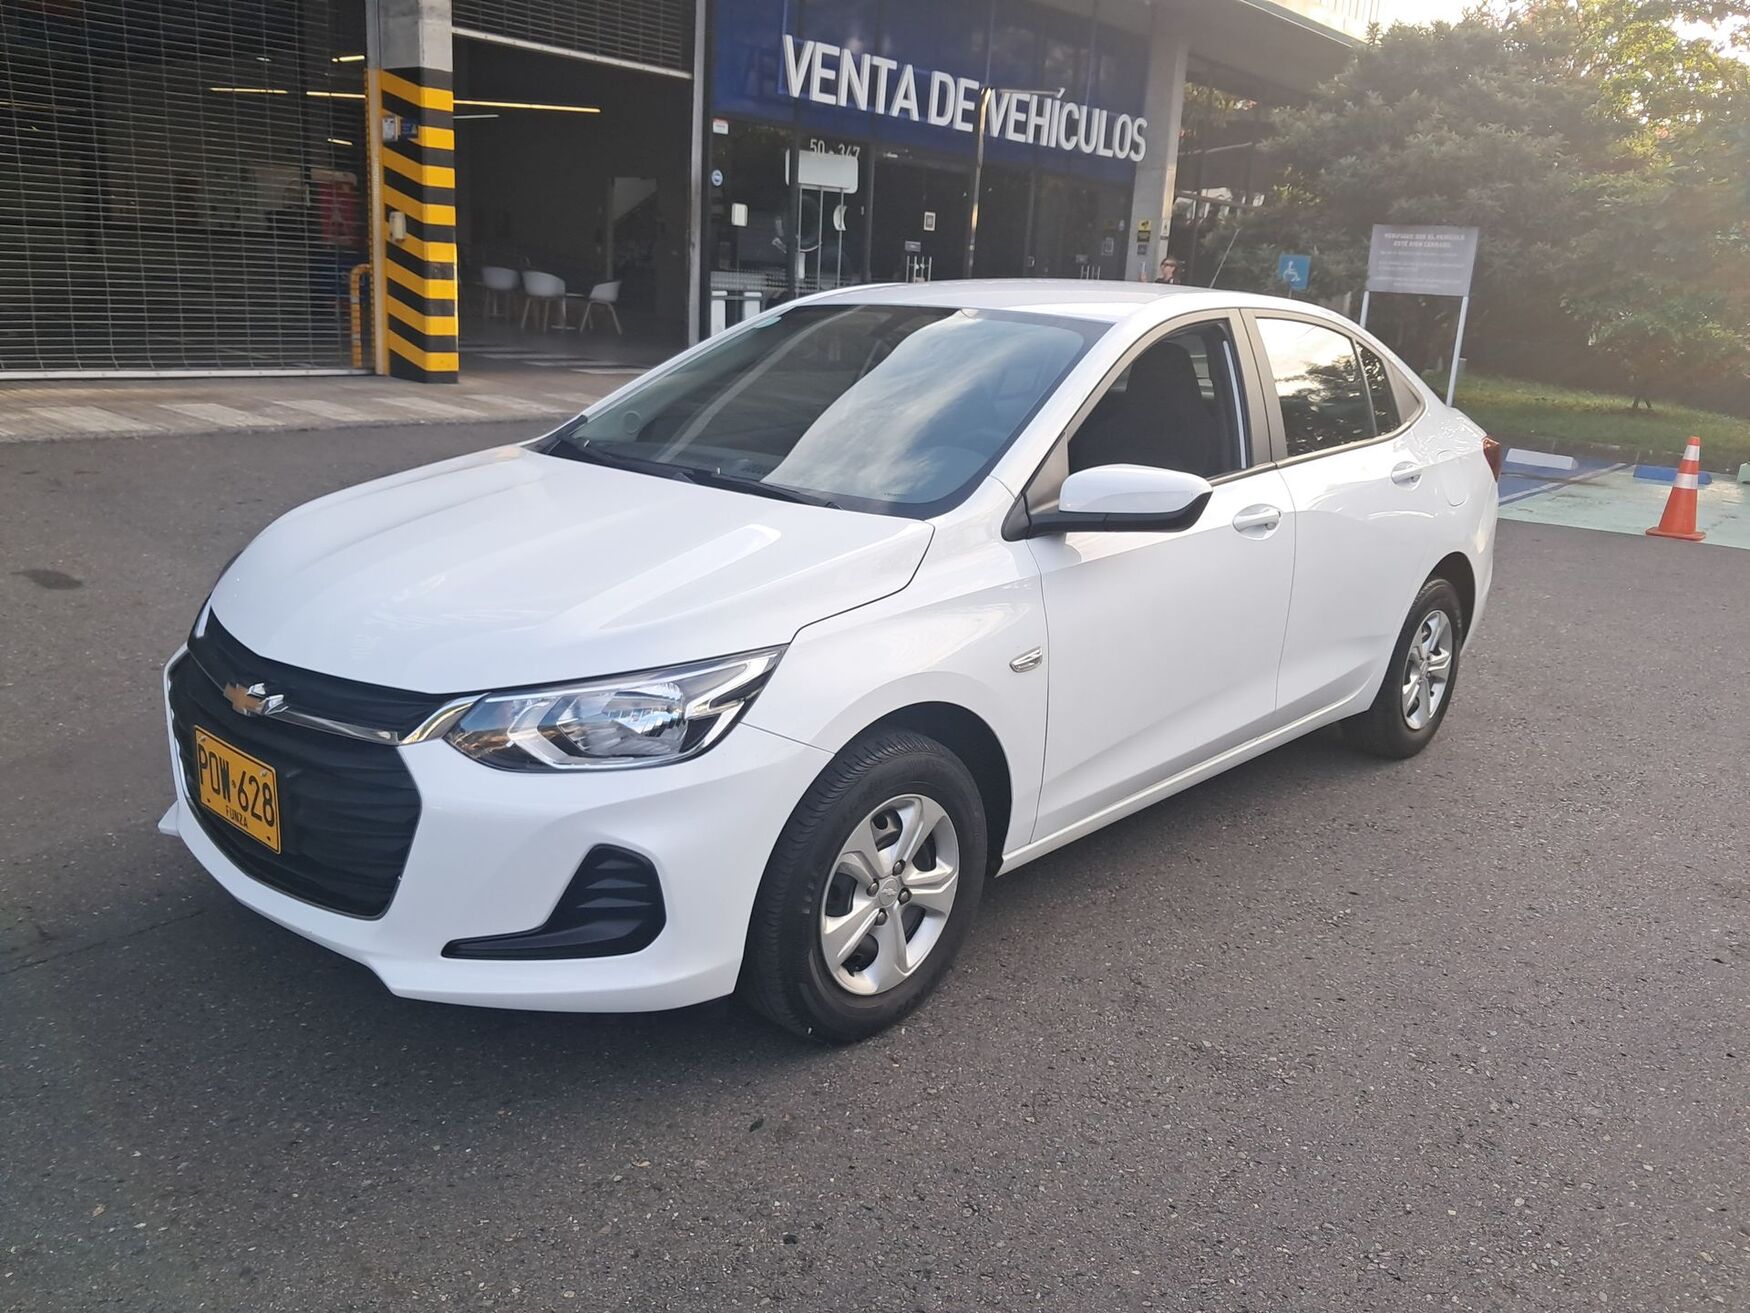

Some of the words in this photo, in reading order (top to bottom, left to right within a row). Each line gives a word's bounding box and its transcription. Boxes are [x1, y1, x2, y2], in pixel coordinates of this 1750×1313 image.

[783, 34, 919, 122] VENTA
[928, 70, 980, 132] DE
[987, 87, 1148, 162] VEHÍCULOS
[810, 138, 825, 153] 50
[225, 805, 249, 829] FUNZA
